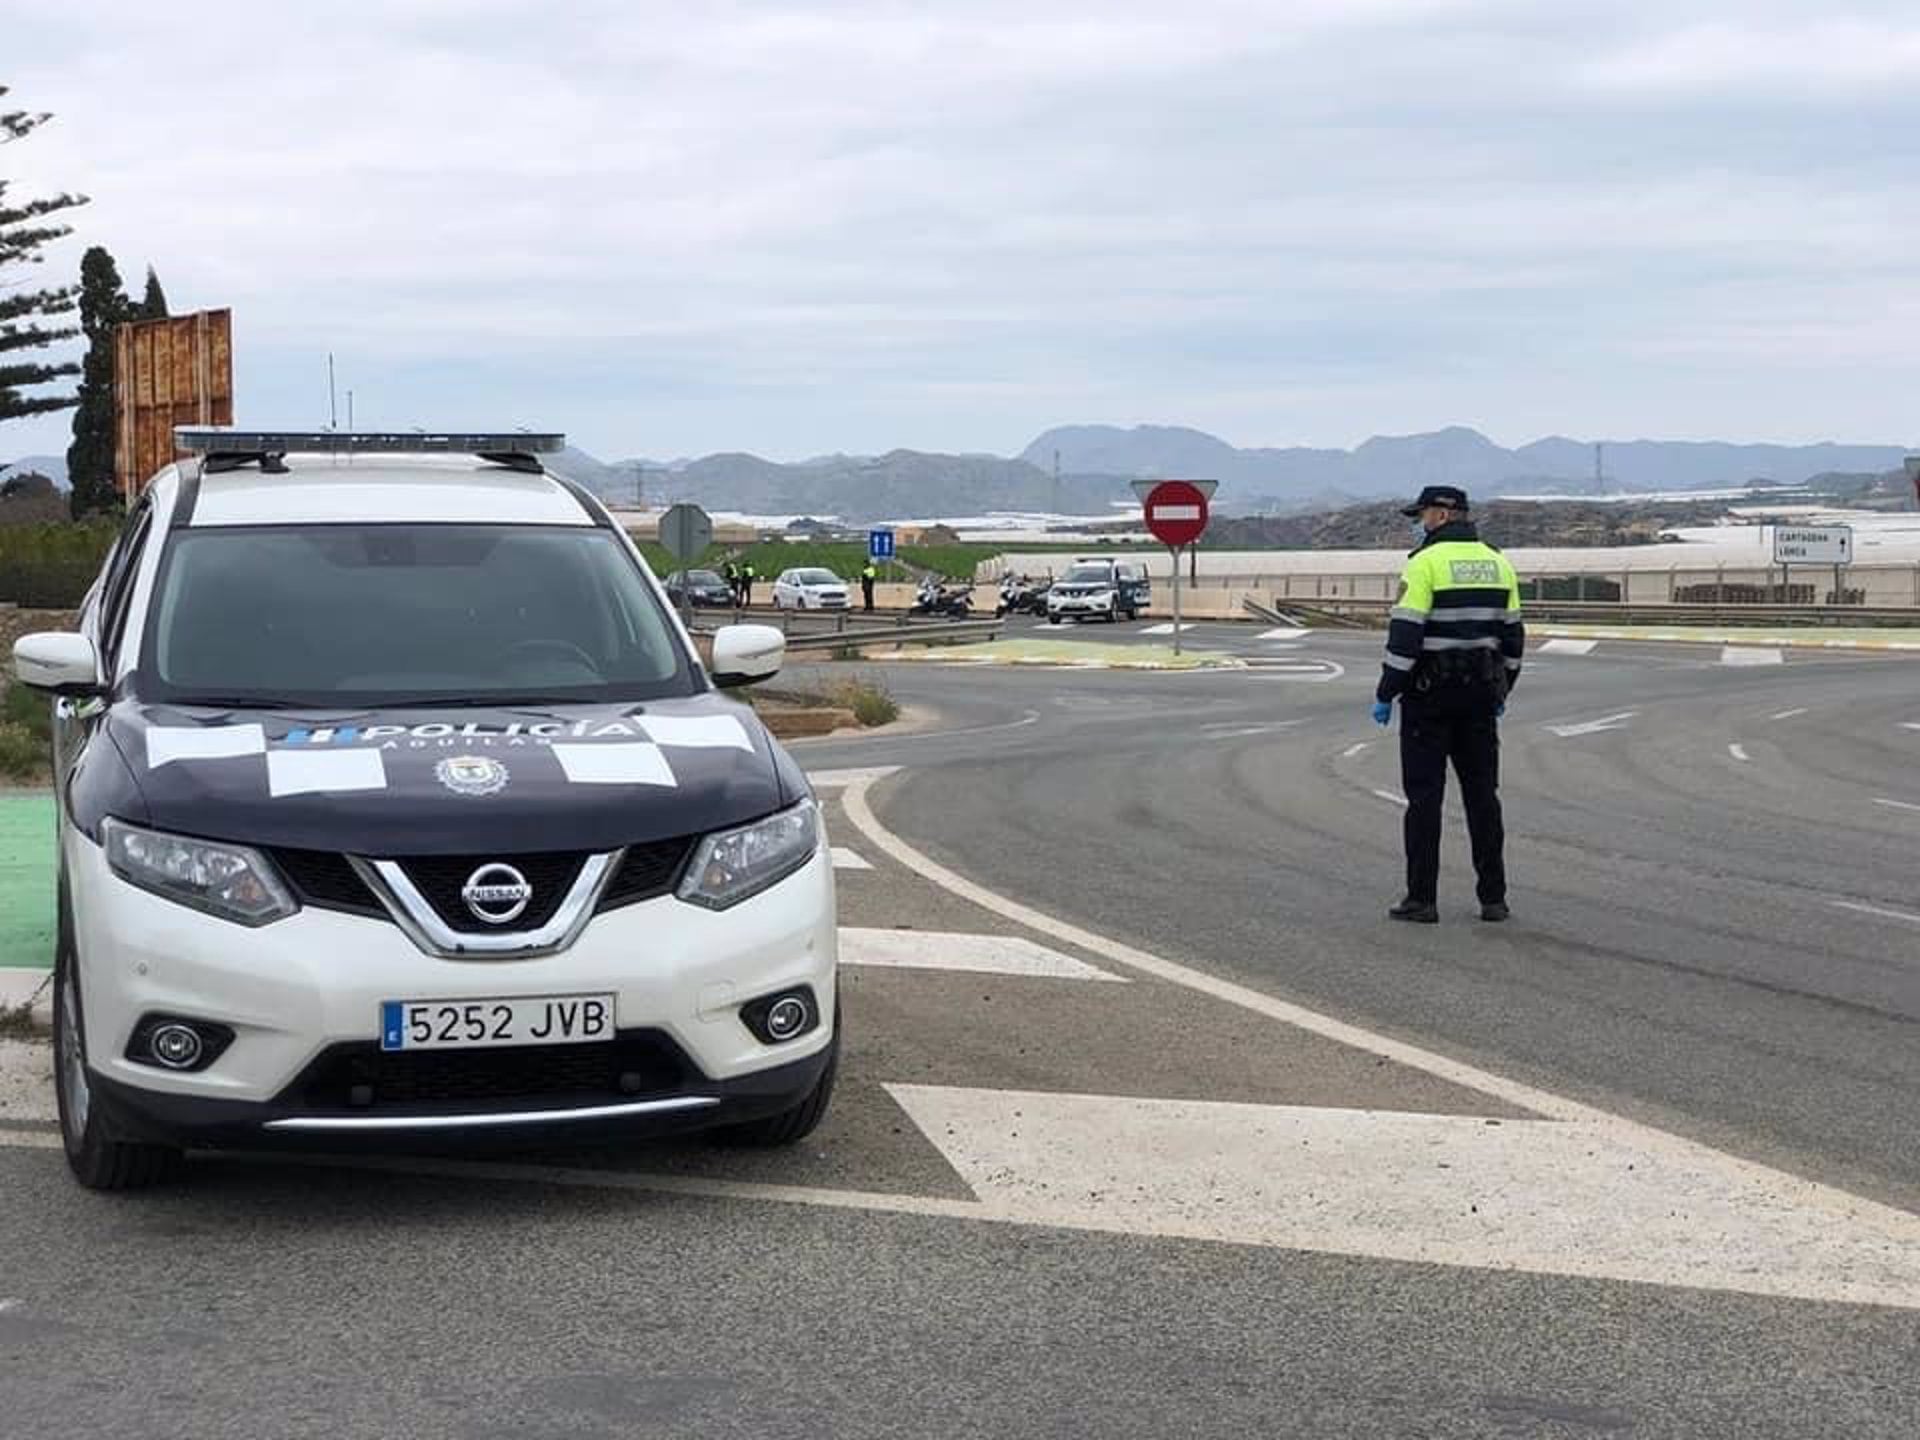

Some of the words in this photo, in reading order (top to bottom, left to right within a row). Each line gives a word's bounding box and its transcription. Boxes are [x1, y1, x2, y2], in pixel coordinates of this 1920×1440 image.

[468, 886, 526, 901] NISSAN
[410, 1006, 513, 1042] 5252
[531, 1001, 605, 1037] JVB
